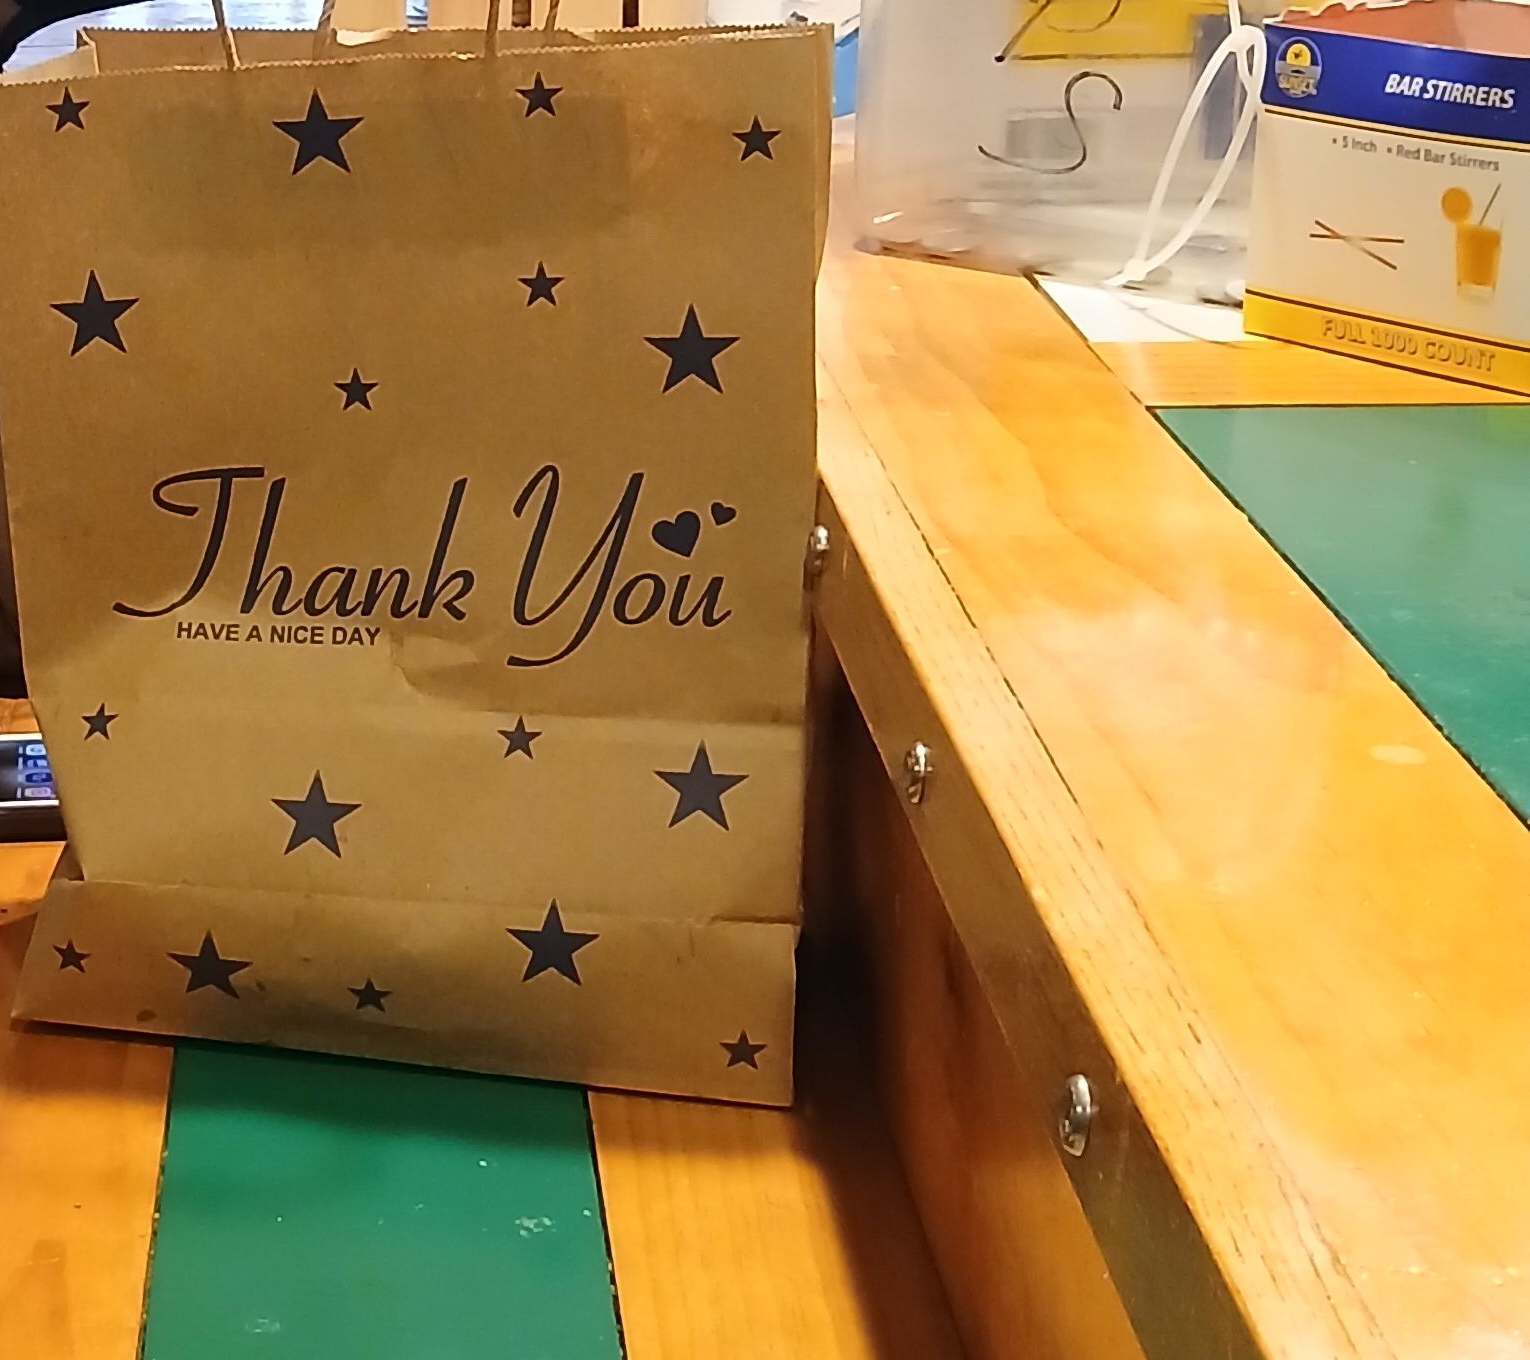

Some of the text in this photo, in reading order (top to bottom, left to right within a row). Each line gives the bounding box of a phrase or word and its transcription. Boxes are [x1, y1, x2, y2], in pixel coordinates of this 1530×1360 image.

[1385, 74, 1515, 108] BAR STIRRERS
[1342, 136, 1377, 153] 5 Inch
[1396, 146, 1499, 171] Red Bar Stirrers
[1322, 316, 1496, 372] FULL 1000 COUNT
[113, 464, 733, 667] Thank You
[176, 621, 381, 646] HAVE A NICE DAY
